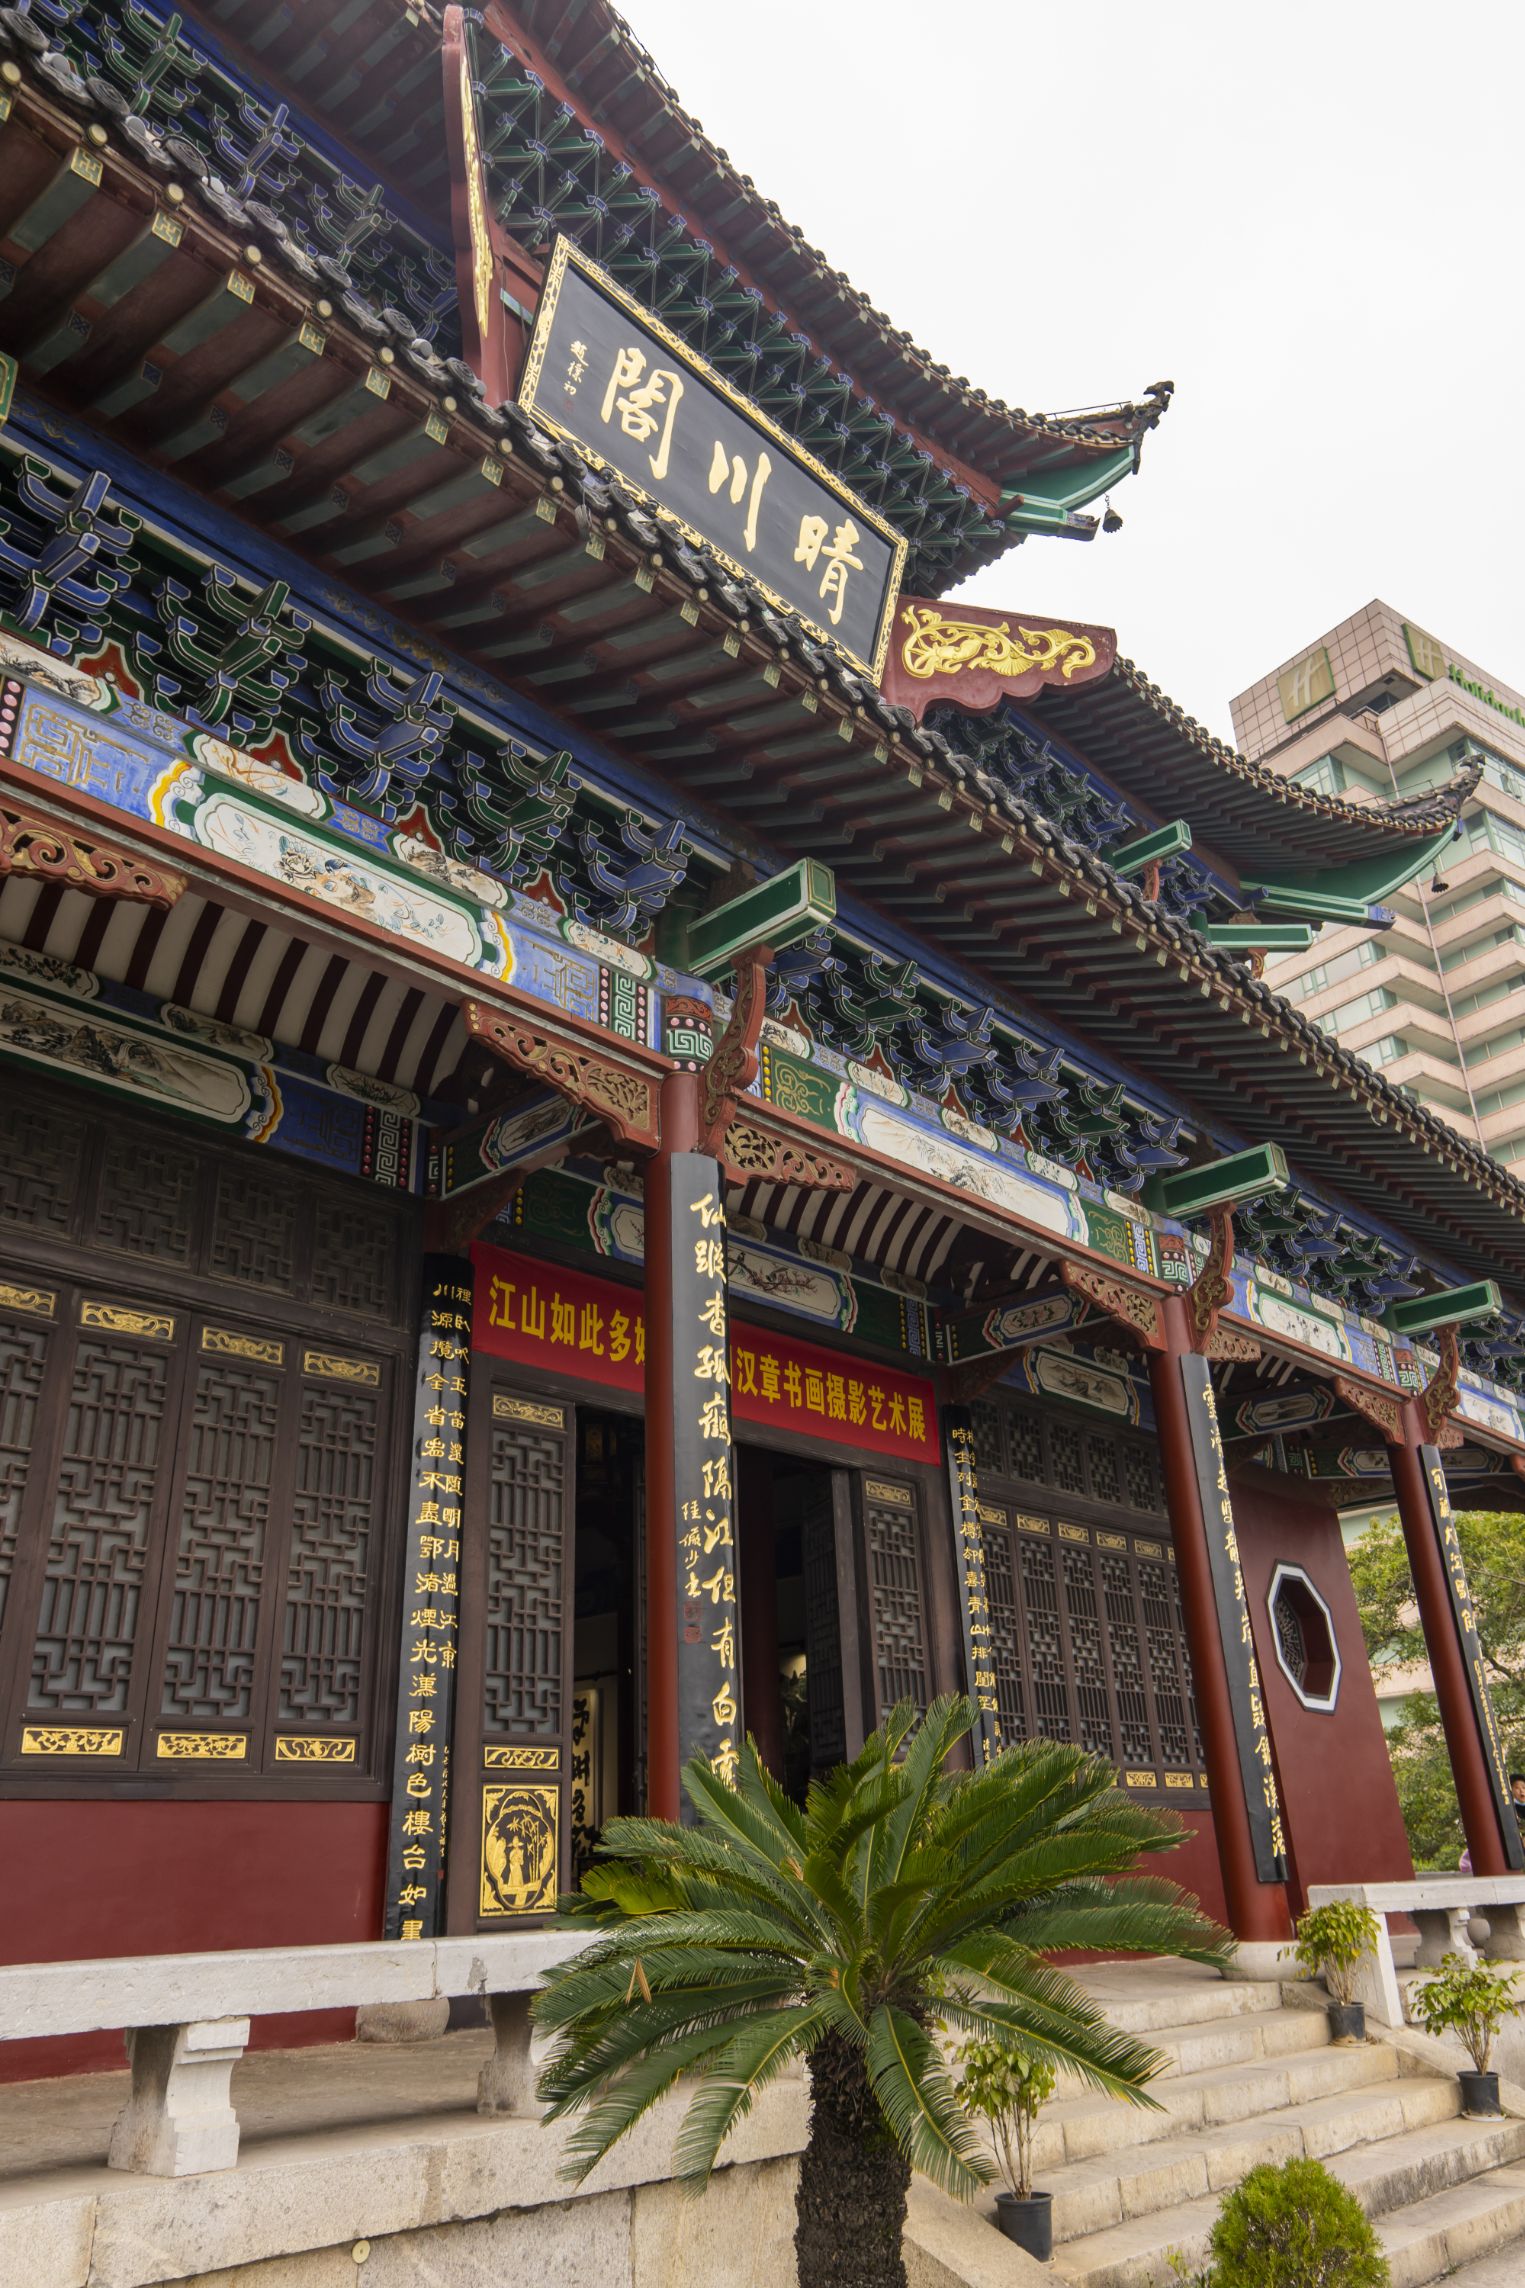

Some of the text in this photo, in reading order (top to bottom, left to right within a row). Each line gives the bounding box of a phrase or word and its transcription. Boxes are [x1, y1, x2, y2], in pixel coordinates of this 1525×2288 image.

[601, 347, 864, 625] 晴川閣
[730, 1344, 926, 1442] 汉章书画摄影艺术展
